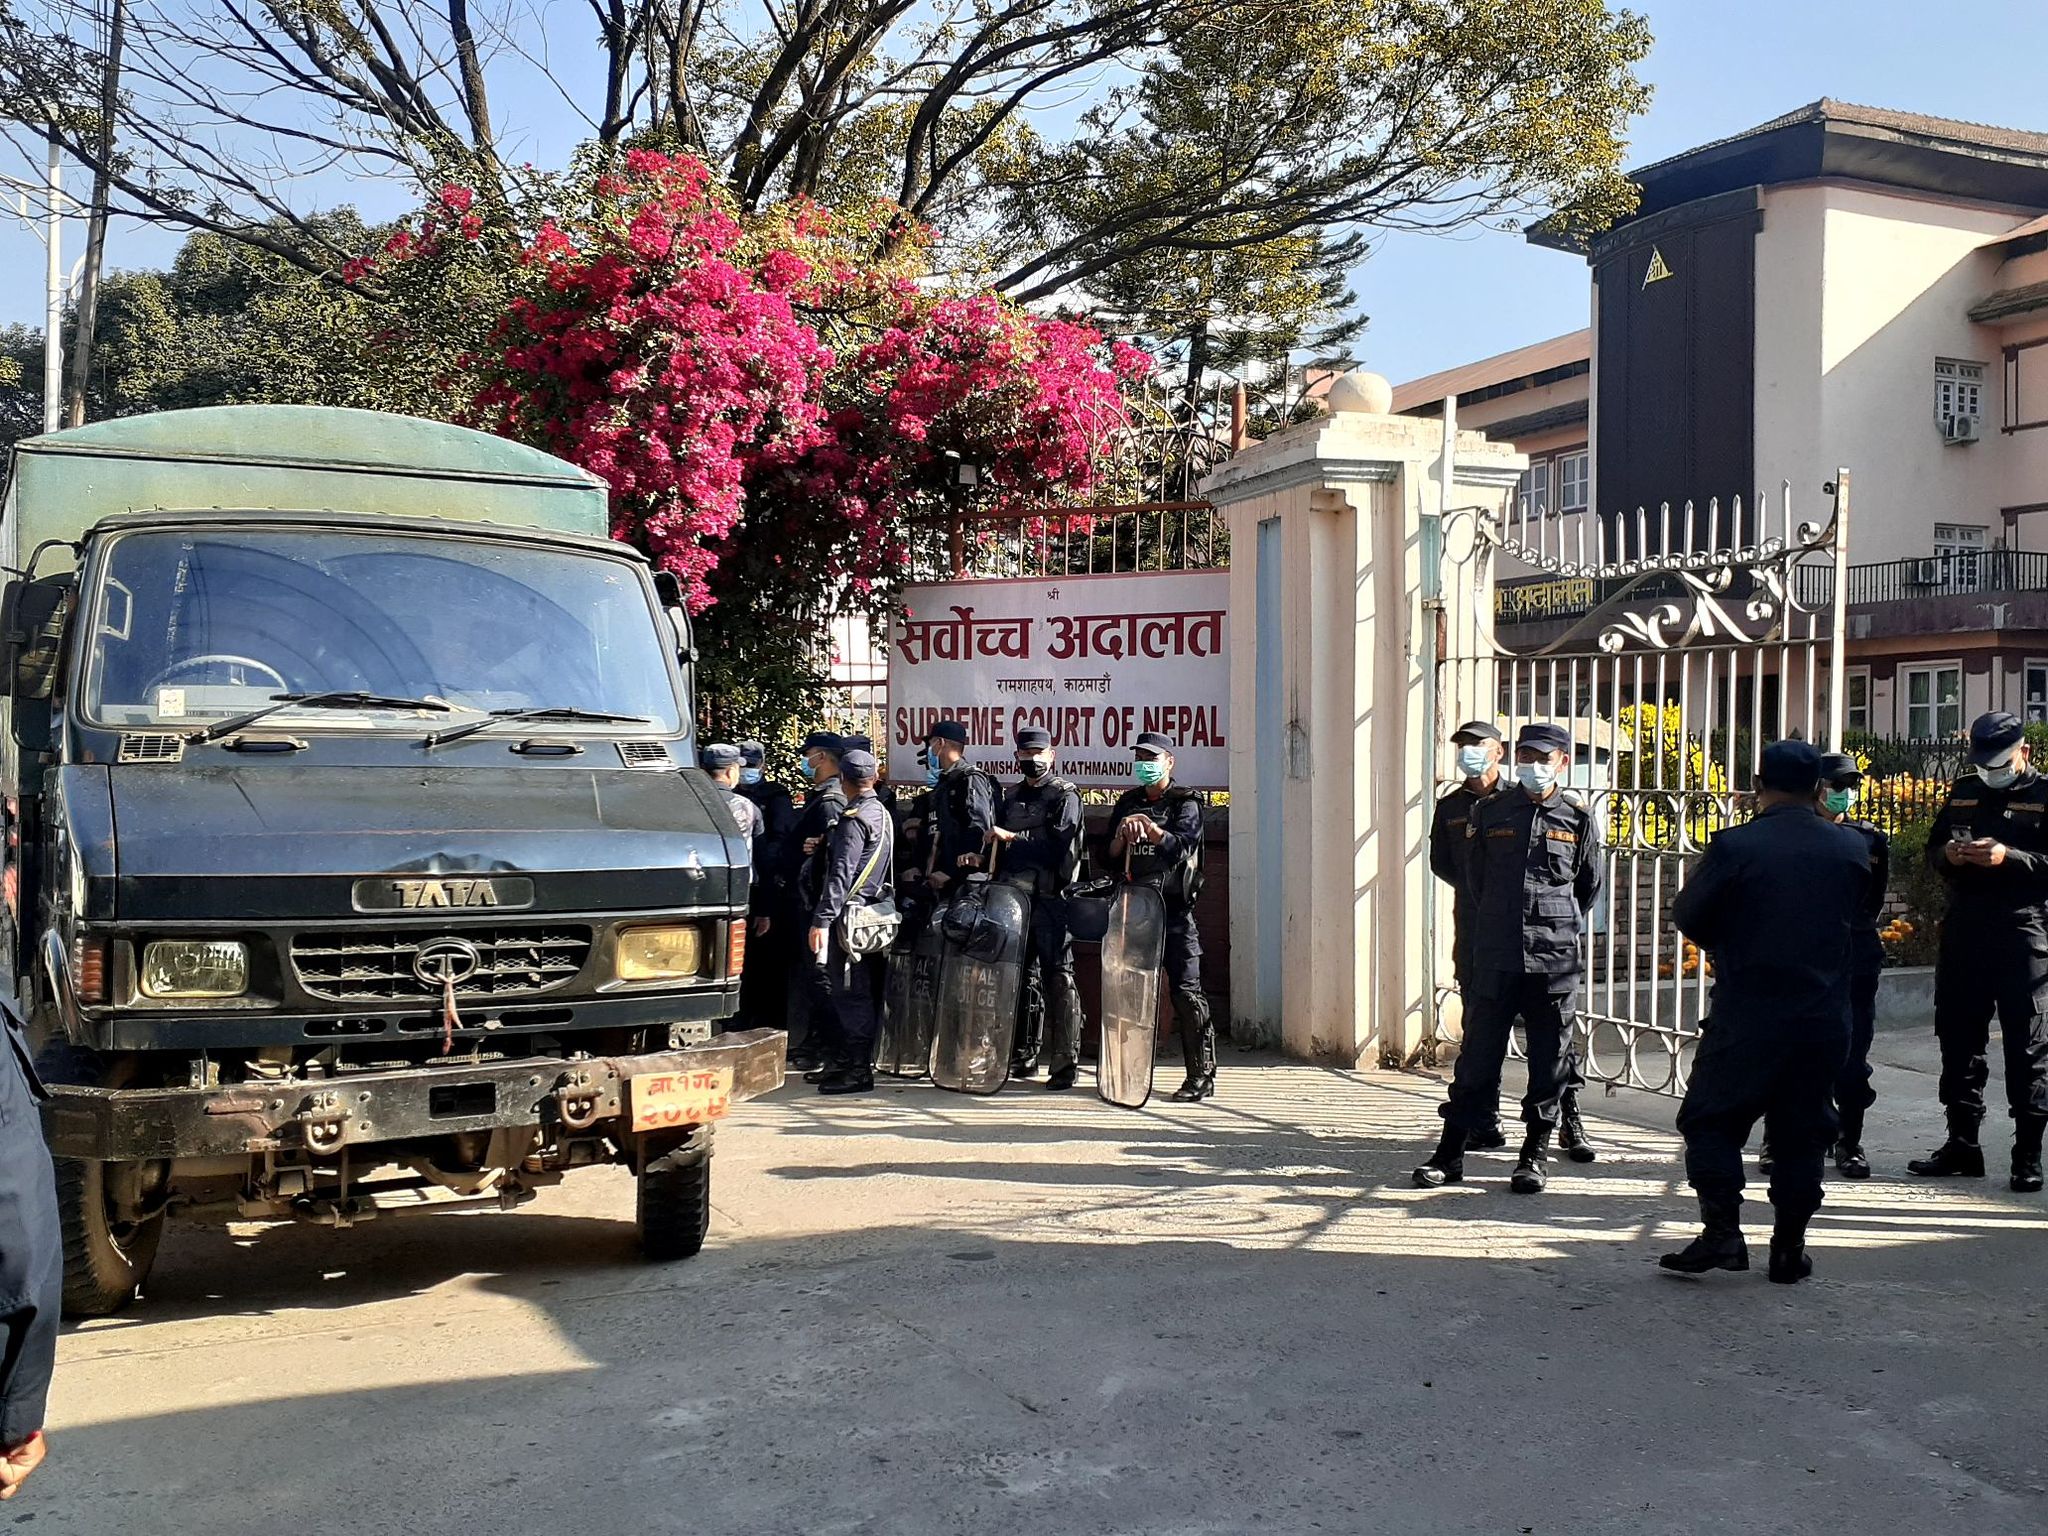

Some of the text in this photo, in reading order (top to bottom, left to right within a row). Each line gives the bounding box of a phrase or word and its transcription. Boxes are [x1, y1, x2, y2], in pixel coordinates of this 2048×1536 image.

[1047, 586, 1060, 600] श्री
[895, 605, 1226, 665] सर्वोच्च अदालत
[996, 677, 1057, 696] रामशाहपथ,
[1103, 705, 1135, 748] OF
[1143, 703, 1226, 747] NEPAL
[1062, 760, 1133, 777] KATHMANDU
[392, 879, 498, 908] TATA
